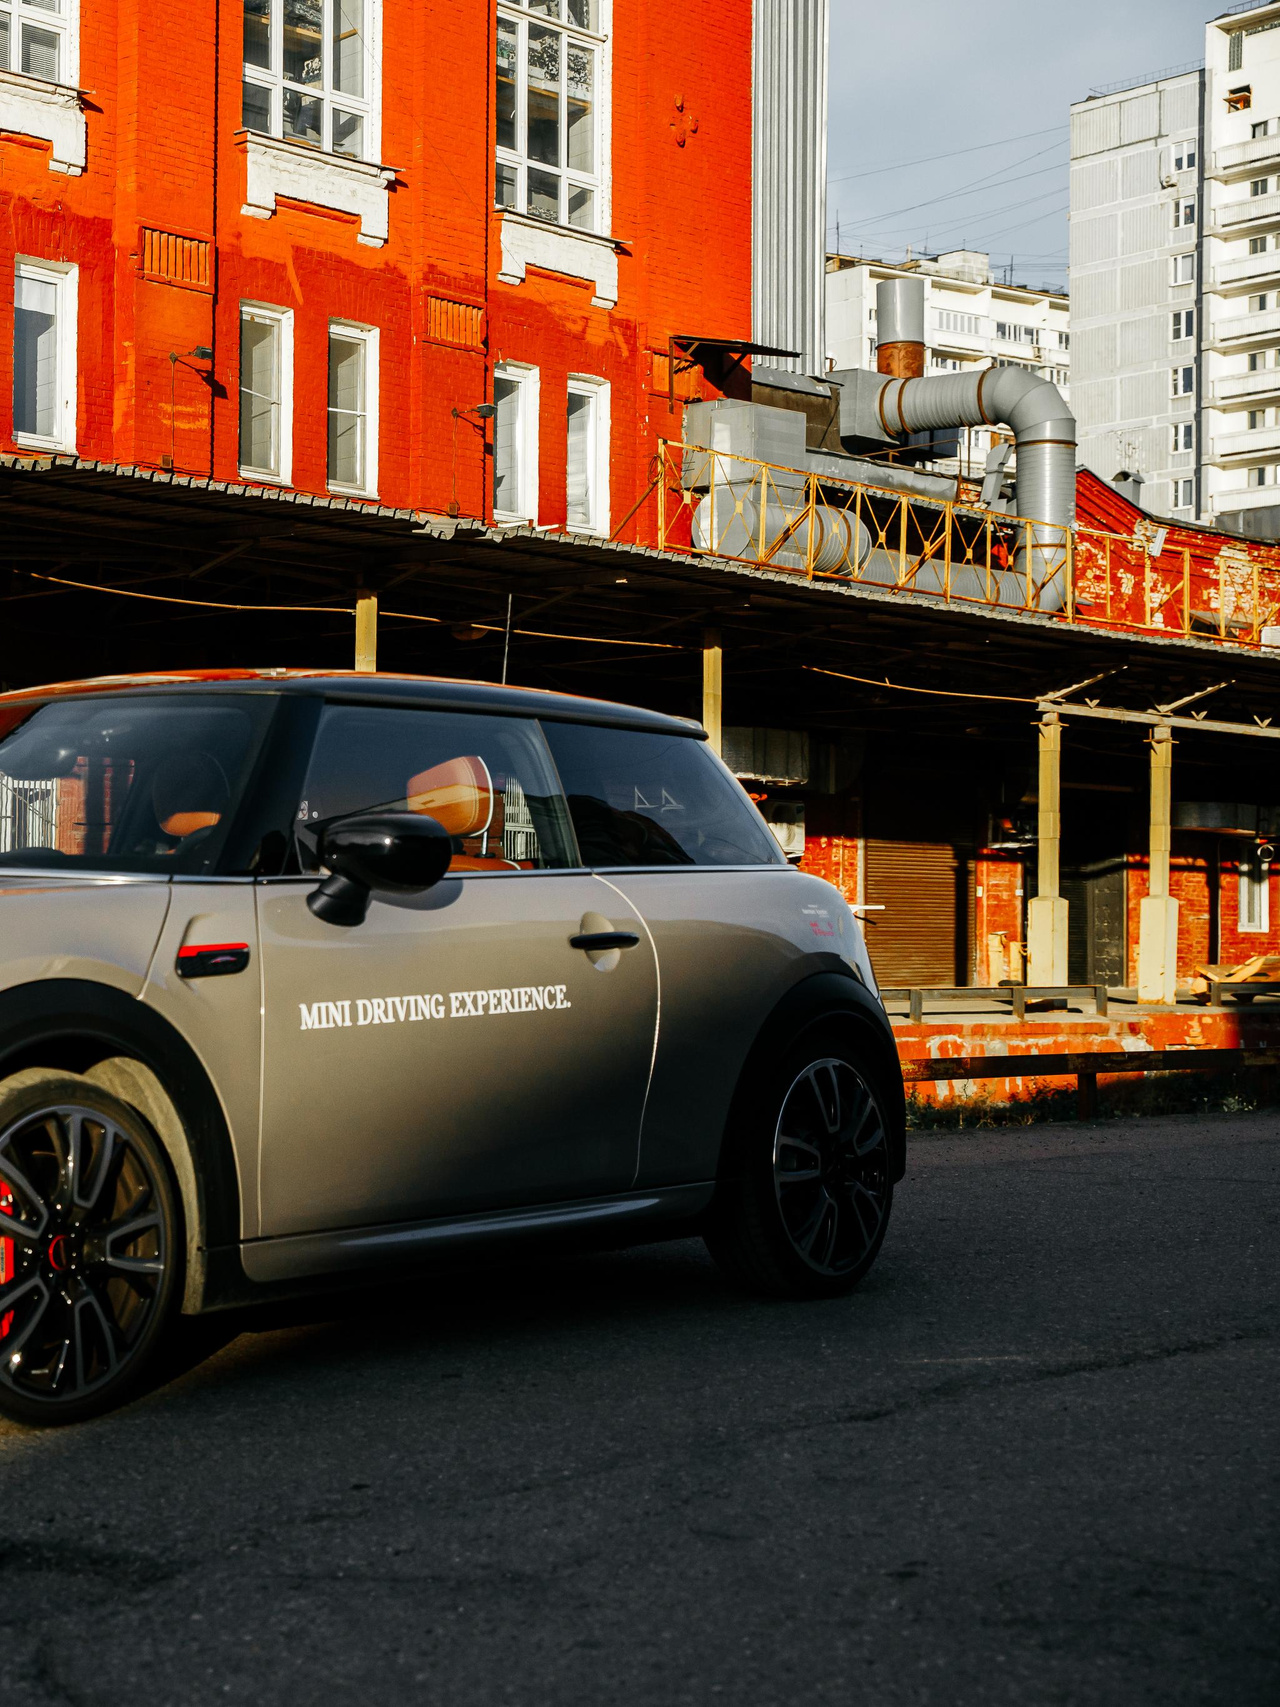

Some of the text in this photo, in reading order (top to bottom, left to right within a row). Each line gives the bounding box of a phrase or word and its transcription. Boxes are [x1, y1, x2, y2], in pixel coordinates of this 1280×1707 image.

[299, 984, 572, 1030] MINI DRIVING EXPERIENCE.
